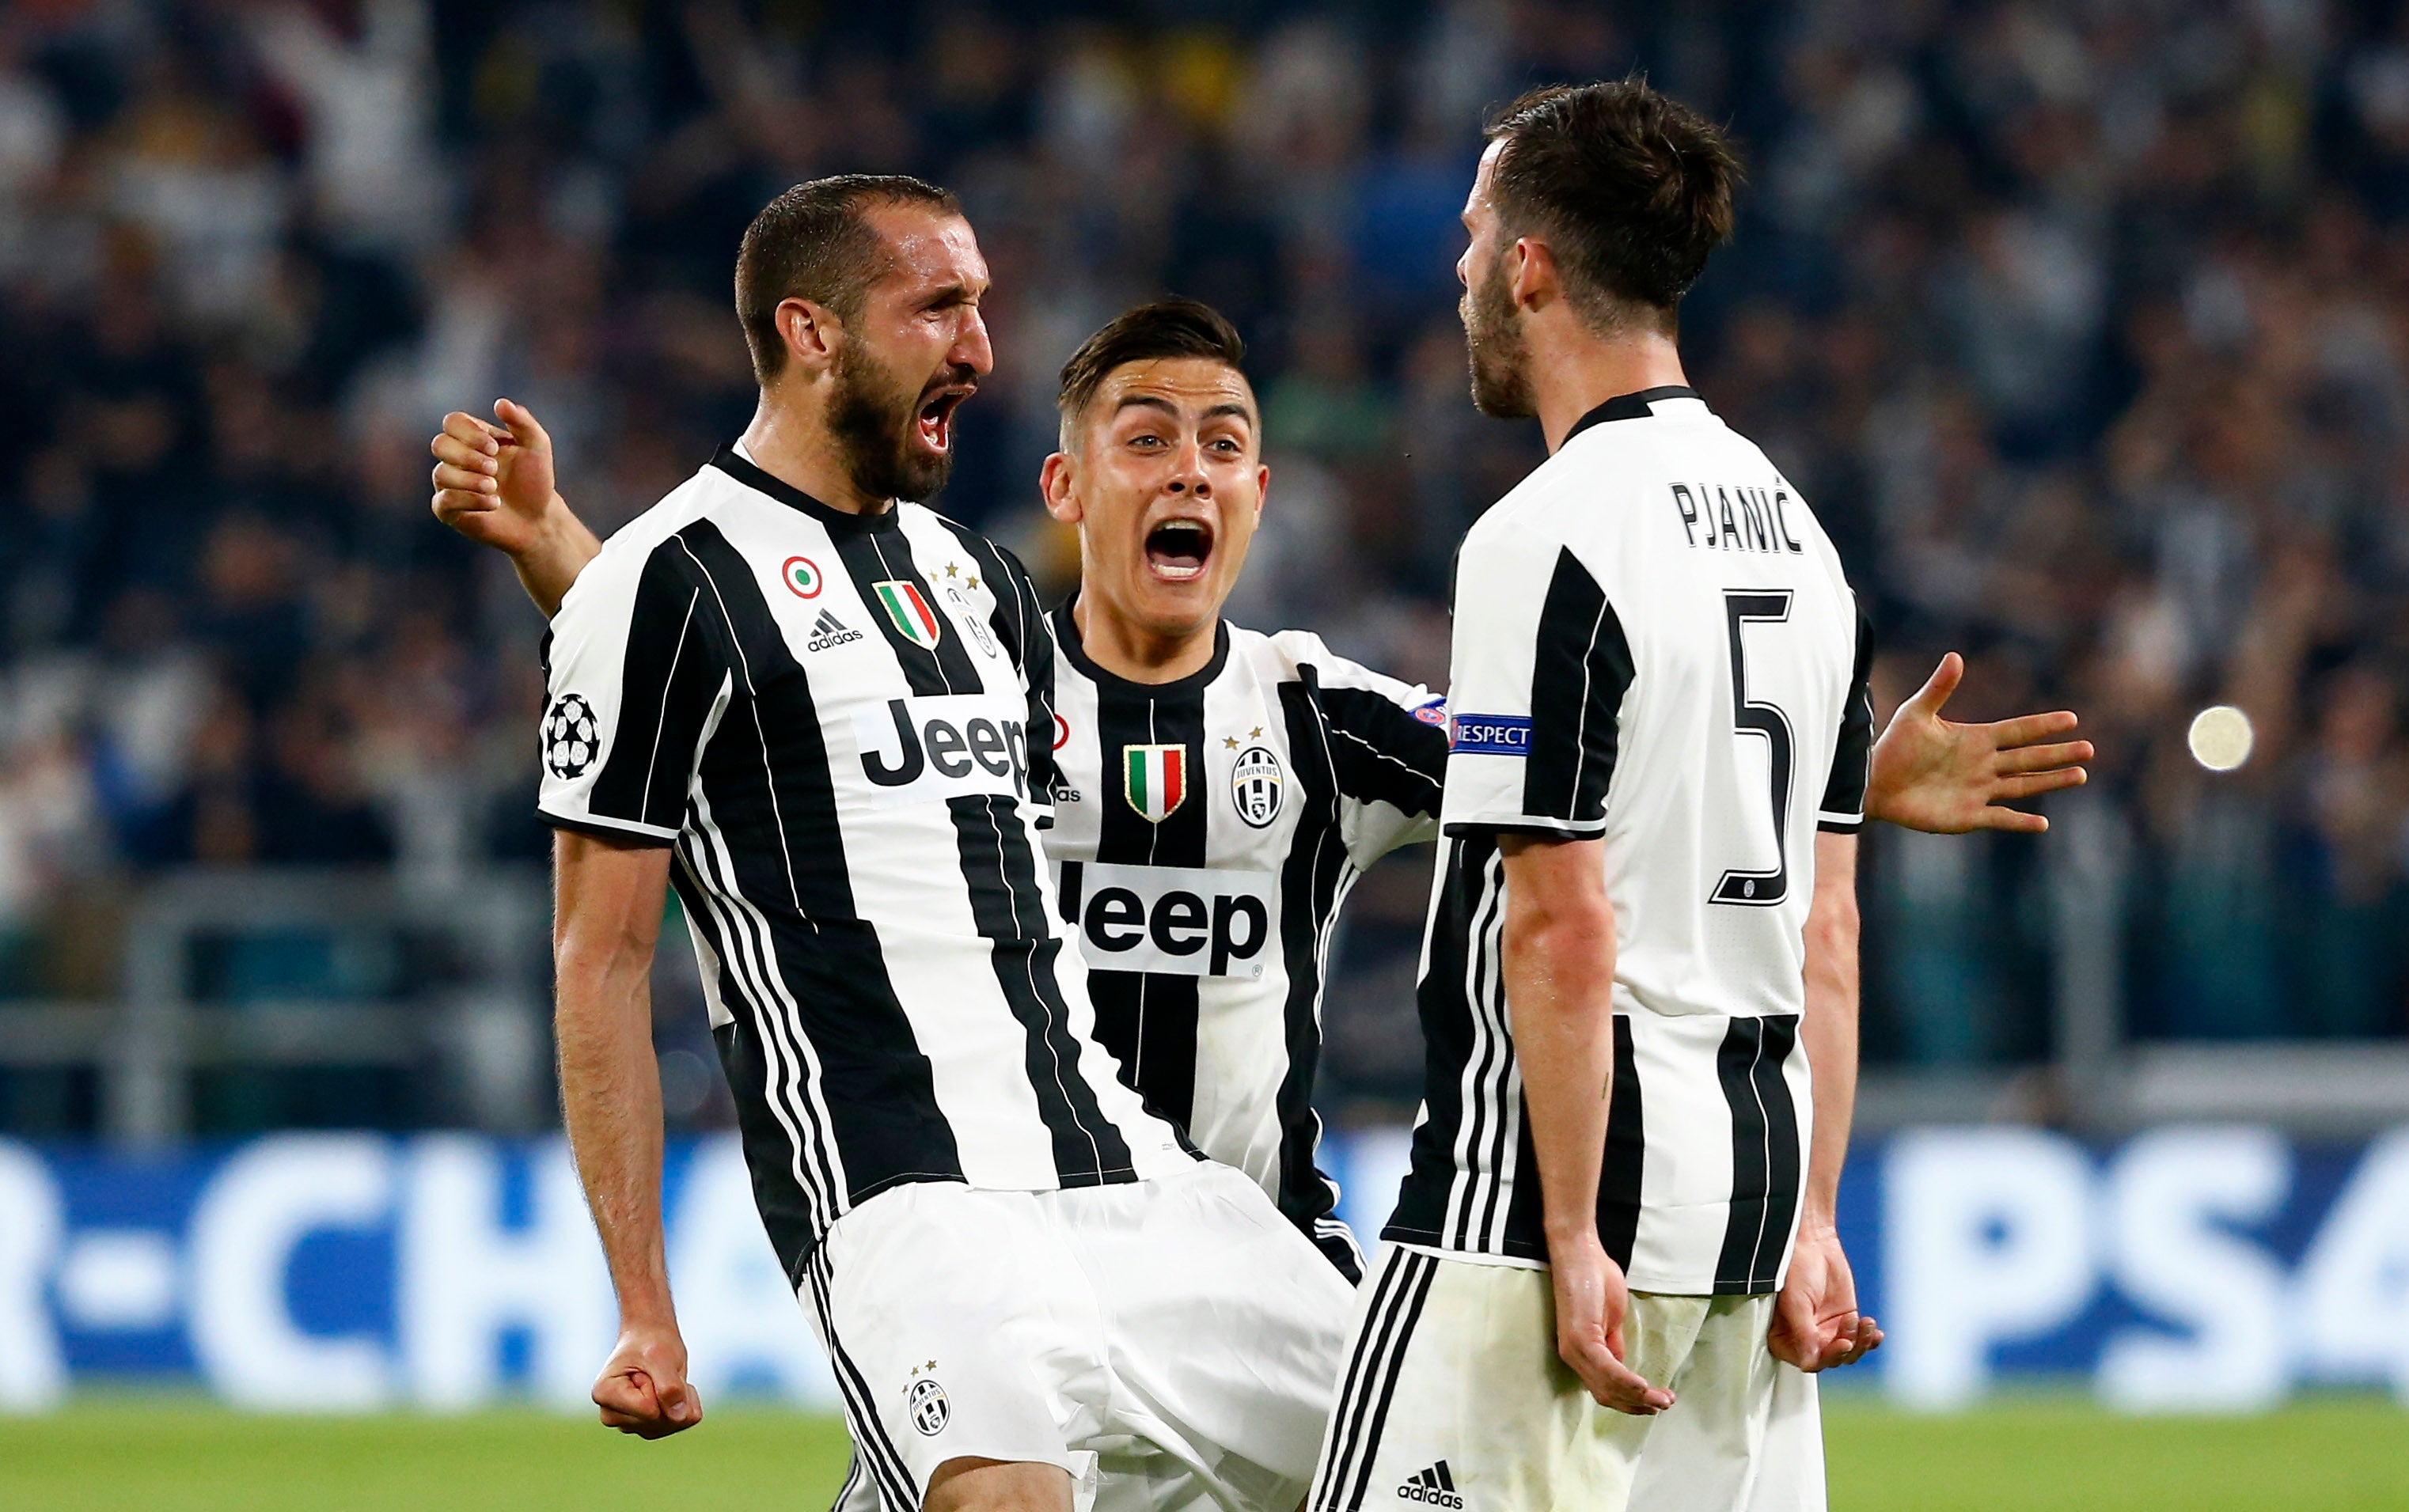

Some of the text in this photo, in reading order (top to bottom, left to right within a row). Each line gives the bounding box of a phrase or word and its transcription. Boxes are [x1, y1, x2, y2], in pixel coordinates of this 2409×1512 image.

[1668, 476, 1804, 554] PJANIĆ
[808, 631, 863, 652] adidas
[860, 699, 1028, 798] Jeep
[1708, 589, 1796, 904] 5
[1237, 766, 1277, 779] JUVENTUS
[1397, 1485, 1463, 1510] adidas
